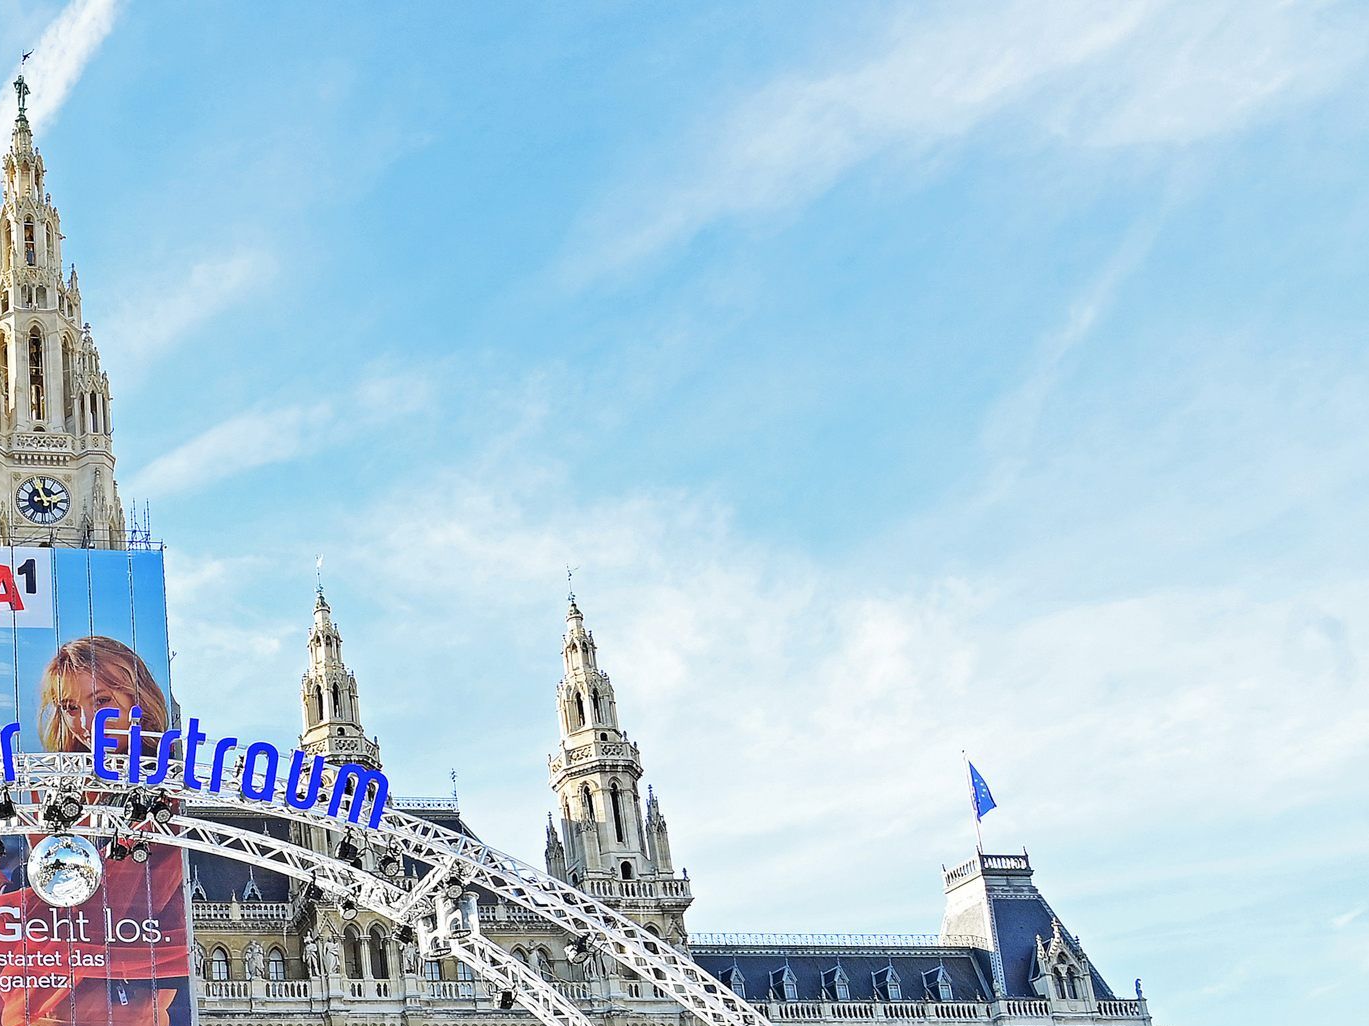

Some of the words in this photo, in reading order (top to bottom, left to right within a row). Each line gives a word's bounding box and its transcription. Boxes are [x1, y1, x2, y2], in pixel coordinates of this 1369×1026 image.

[94, 705, 389, 830] Eistraum
[102, 908, 171, 943] los.
[68, 949, 105, 967] das
